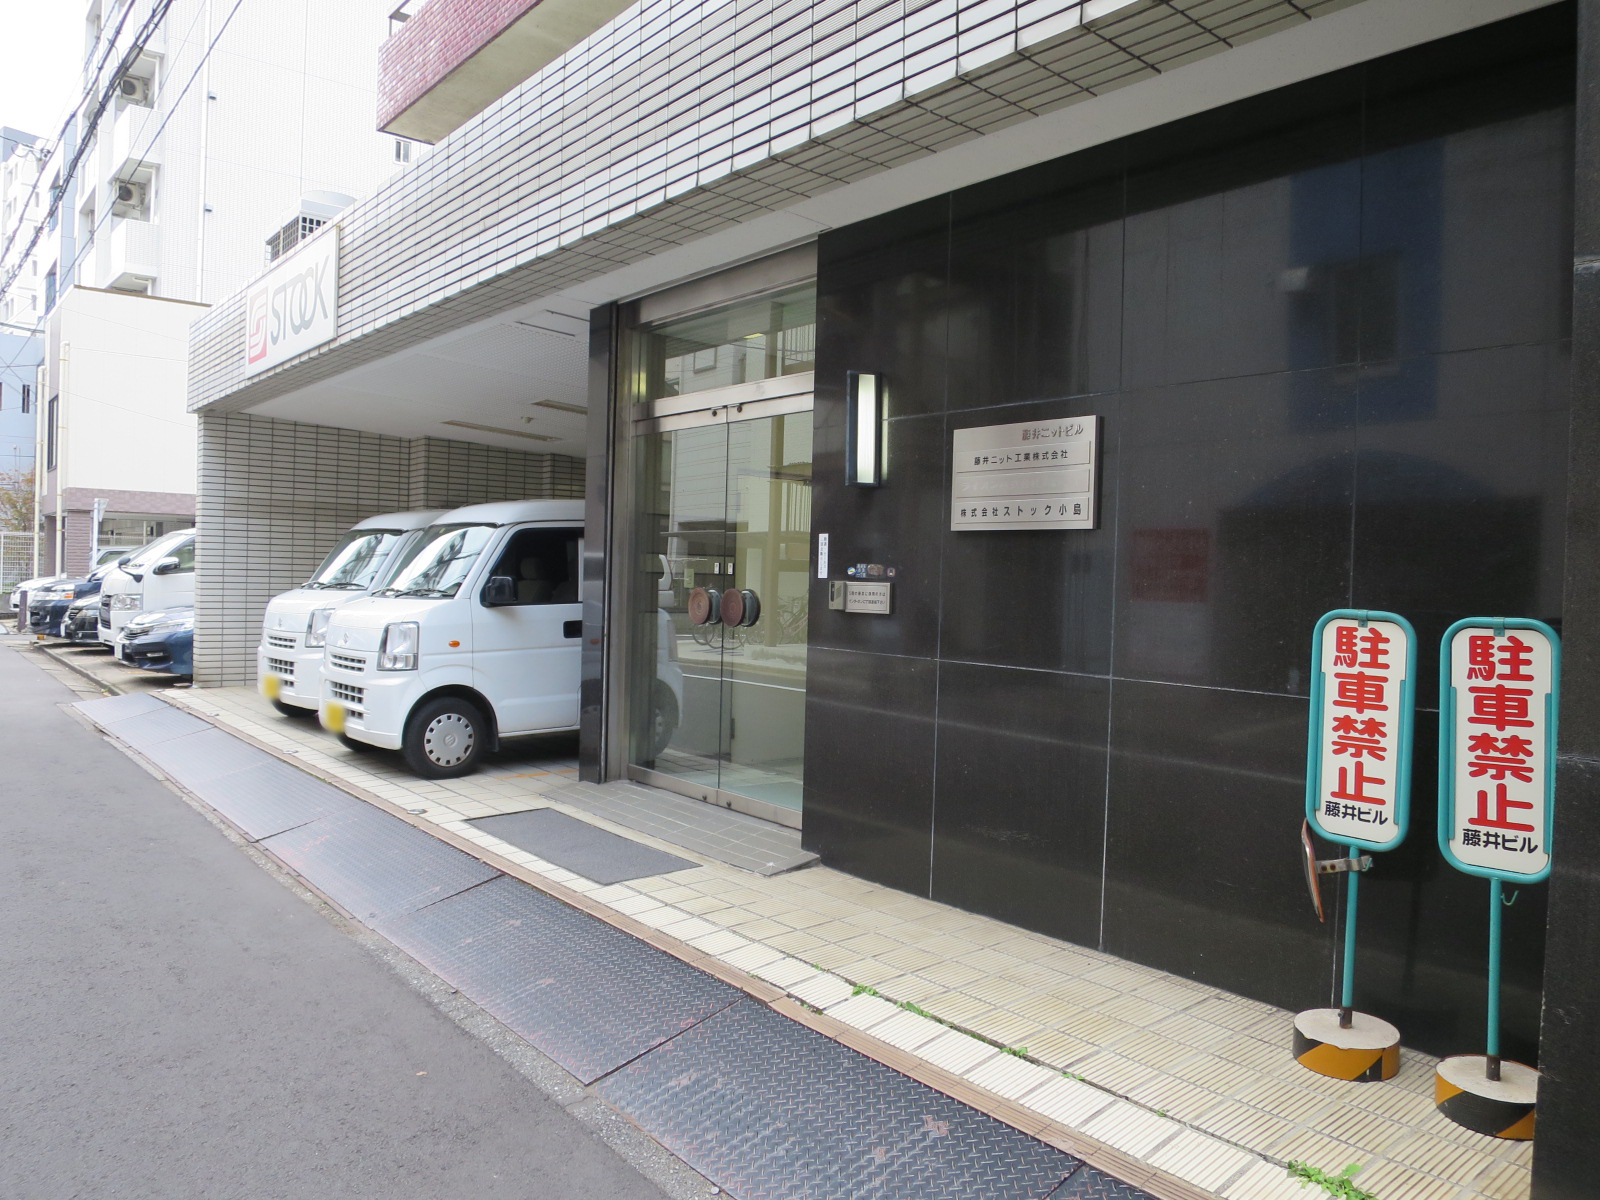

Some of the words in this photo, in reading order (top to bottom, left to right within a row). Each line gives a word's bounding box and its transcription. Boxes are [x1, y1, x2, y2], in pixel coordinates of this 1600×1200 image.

[270, 254, 330, 346] STOCK
[974, 449, 1069, 466] 藤井ニット工業株式会社
[960, 503, 1082, 518] 株式会社ストック小島
[1330, 625, 1391, 806] 駐車禁止
[1466, 634, 1535, 833] 駐車禁止
[1324, 800, 1389, 826] 藤井ビル
[1462, 828, 1538, 854] 藤井ビル
